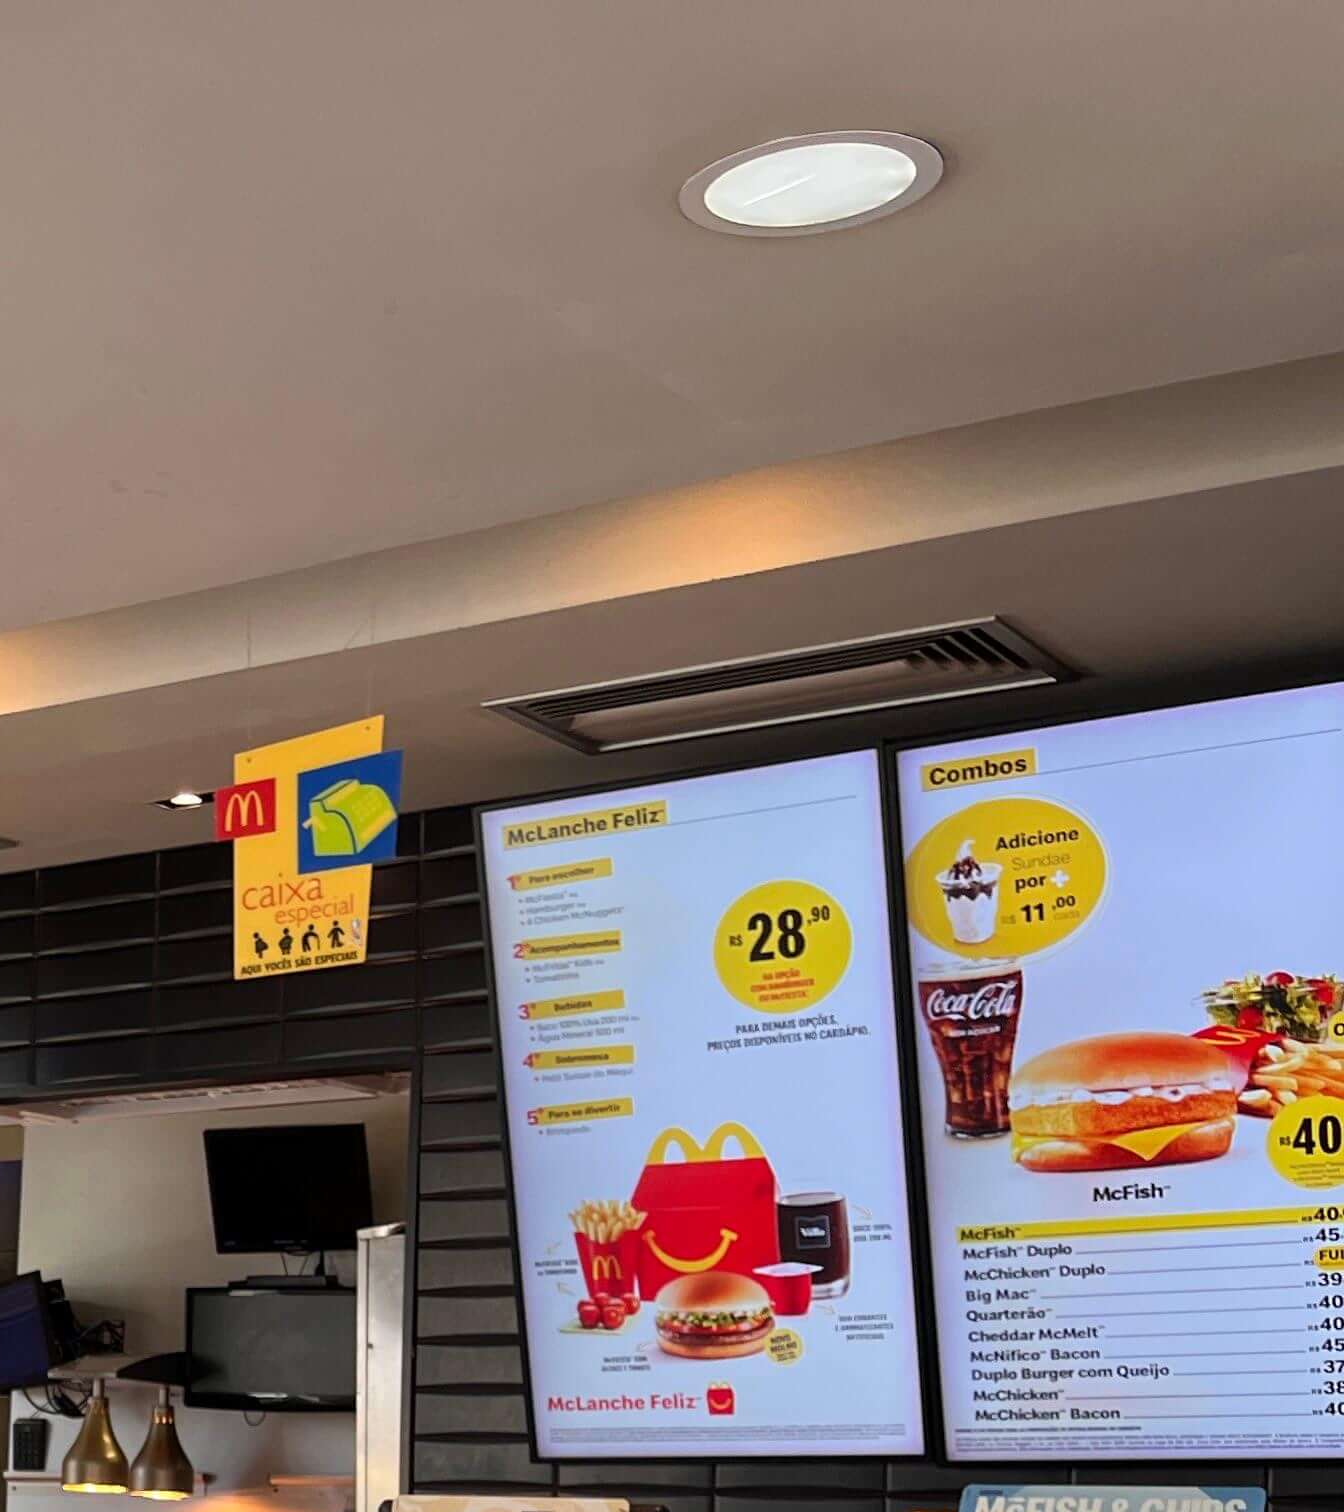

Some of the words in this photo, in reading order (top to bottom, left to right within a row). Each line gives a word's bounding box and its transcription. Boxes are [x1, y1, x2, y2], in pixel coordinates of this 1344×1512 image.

[929, 756, 1028, 786] Combos
[508, 816, 607, 846] McLanche
[613, 808, 660, 829] Feliz
[996, 829, 1079, 851] Adicione
[1012, 852, 1072, 871] Sundae
[242, 873, 324, 911] caixa
[1015, 874, 1047, 893] por
[275, 894, 354, 928] especial
[241, 963, 262, 975] AQUI
[264, 957, 292, 972] VOCÊS
[294, 954, 312, 968] SÃO
[315, 951, 358, 964] ESPECIAIS
[1027, 1243, 1073, 1259] Duplo
[1059, 1263, 1106, 1279] Duplo
[966, 1290, 992, 1304] Big
[968, 1329, 1035, 1342] Cheddar
[1050, 1348, 1101, 1361] Bacon
[971, 1368, 1017, 1383] Duplo
[1021, 1367, 1074, 1383] Burger
[1078, 1368, 1113, 1378] com
[1116, 1363, 1170, 1380] Queijo
[547, 1395, 645, 1412] McLanche
[650, 1392, 698, 1410] Feliz
[1070, 1407, 1121, 1420] Bacon
